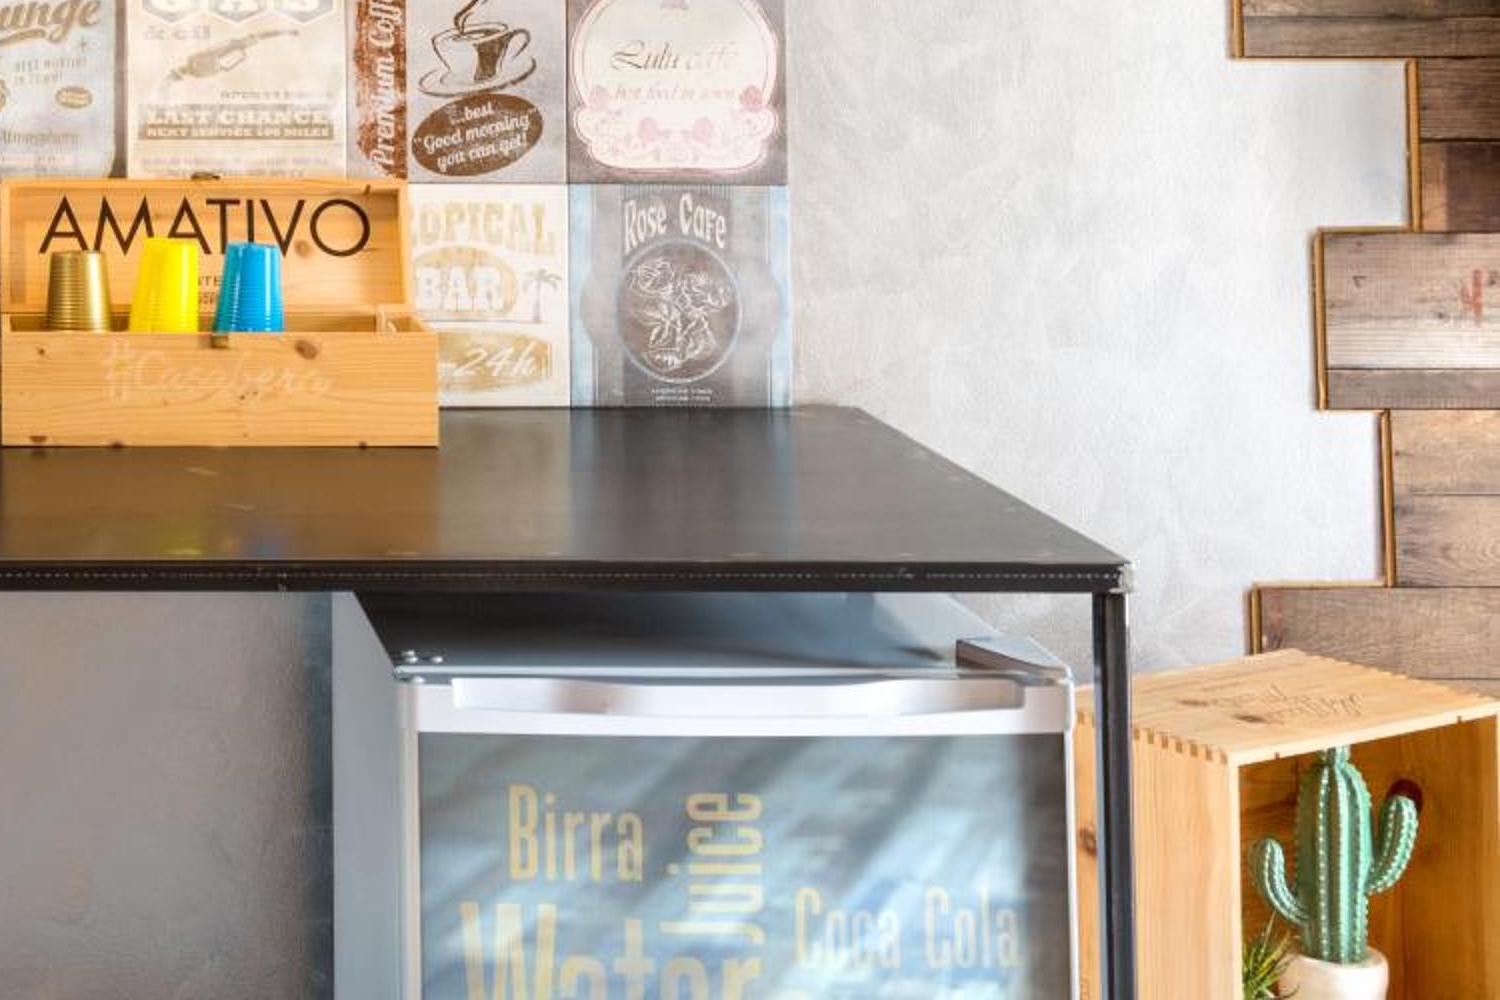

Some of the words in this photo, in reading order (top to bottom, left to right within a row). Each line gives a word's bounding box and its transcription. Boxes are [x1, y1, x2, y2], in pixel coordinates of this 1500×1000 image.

[149, 110, 213, 124] LAST
[218, 110, 328, 125] CHANCE
[370, 54, 396, 169] Premium
[436, 150, 465, 173] you
[468, 144, 496, 161] can
[39, 195, 371, 257] AMATIVO
[411, 201, 556, 258] OPICAL
[624, 199, 668, 255] Rose
[416, 264, 506, 314] BAR
[507, 785, 645, 883] Birra
[658, 792, 766, 945] Juice
[793, 886, 900, 970] Coca
[923, 886, 1024, 970] Cola
